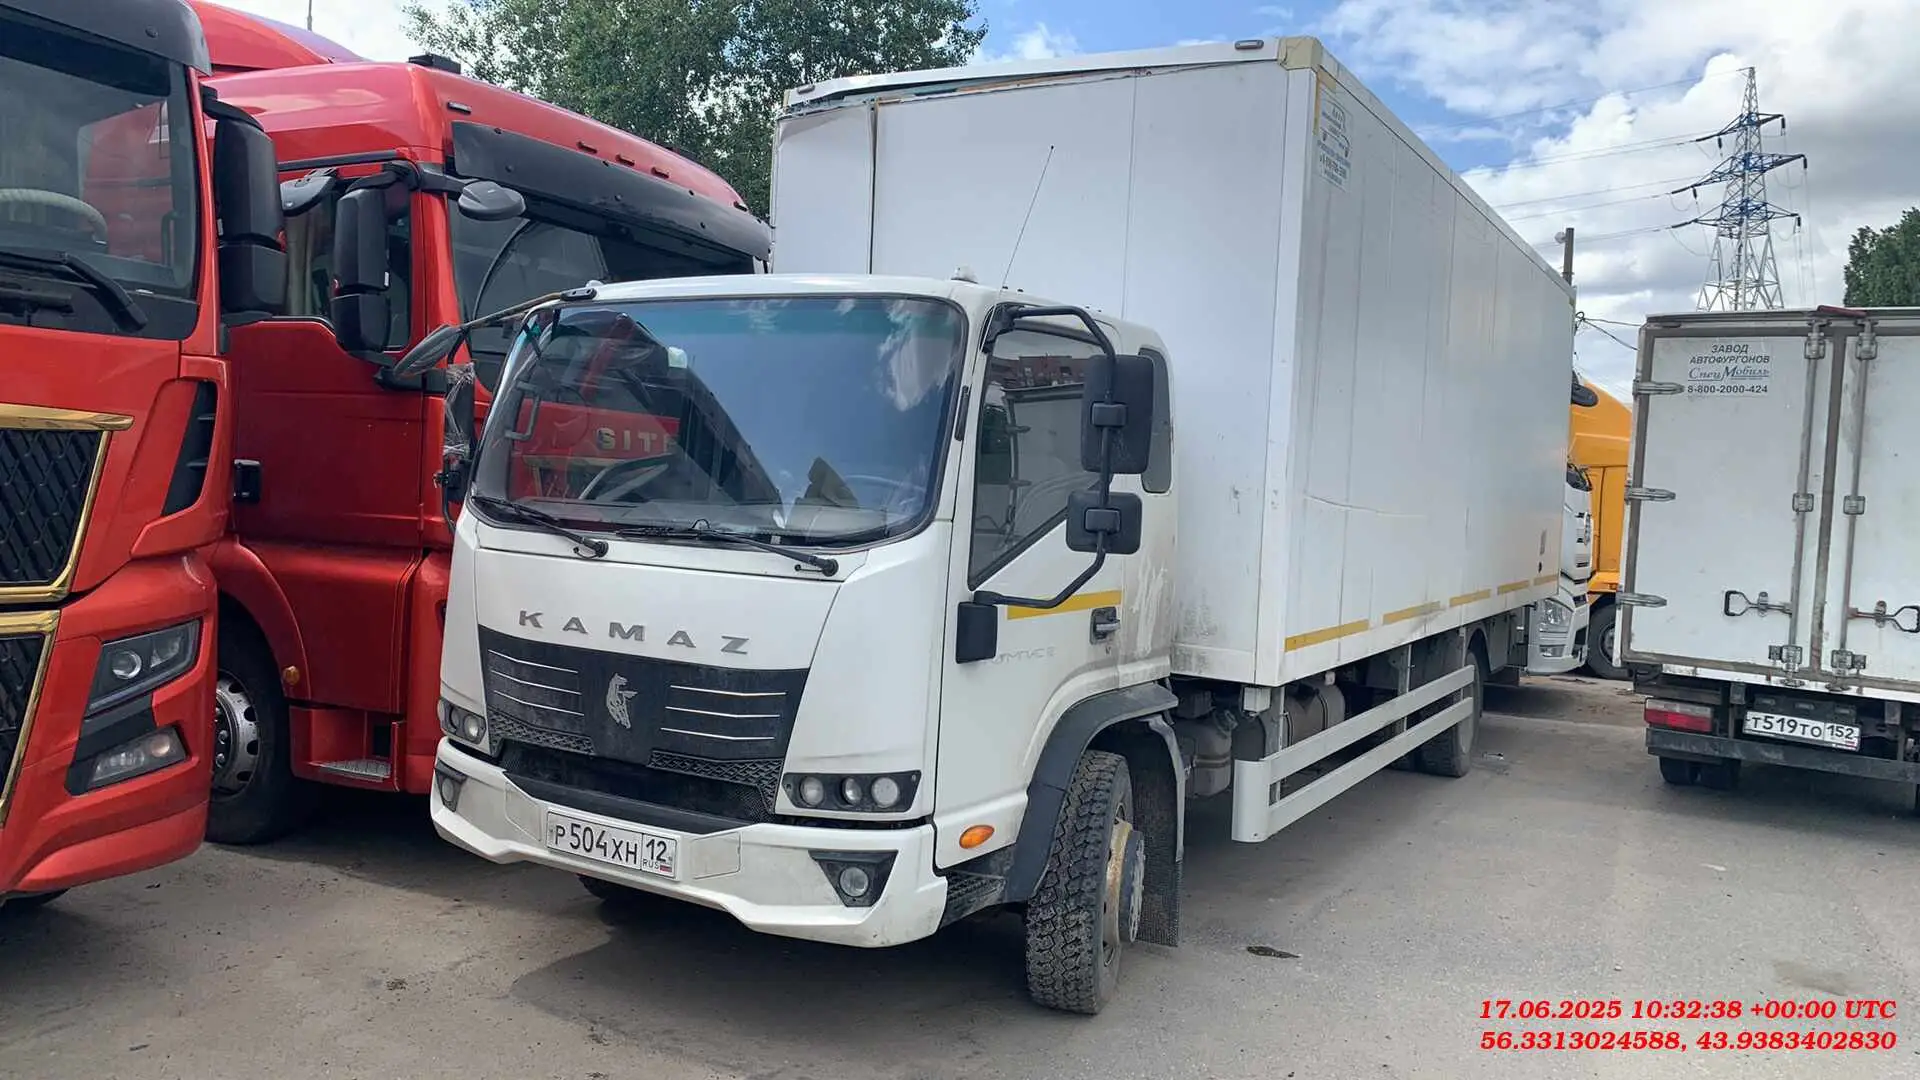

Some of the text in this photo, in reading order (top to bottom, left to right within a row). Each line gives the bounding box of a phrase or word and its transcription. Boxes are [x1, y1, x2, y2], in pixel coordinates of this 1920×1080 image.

[1711, 344, 1749, 354] ЗАВОД
[1689, 355, 1770, 364] АВТОФУРГОНОВ
[1687, 385, 1768, 393] 8-800-2000-424
[519, 610, 750, 655] KAMAZ
[1827, 724, 1855, 740] 152
[646, 838, 667, 863] 12
[642, 858, 660, 870] RUS
